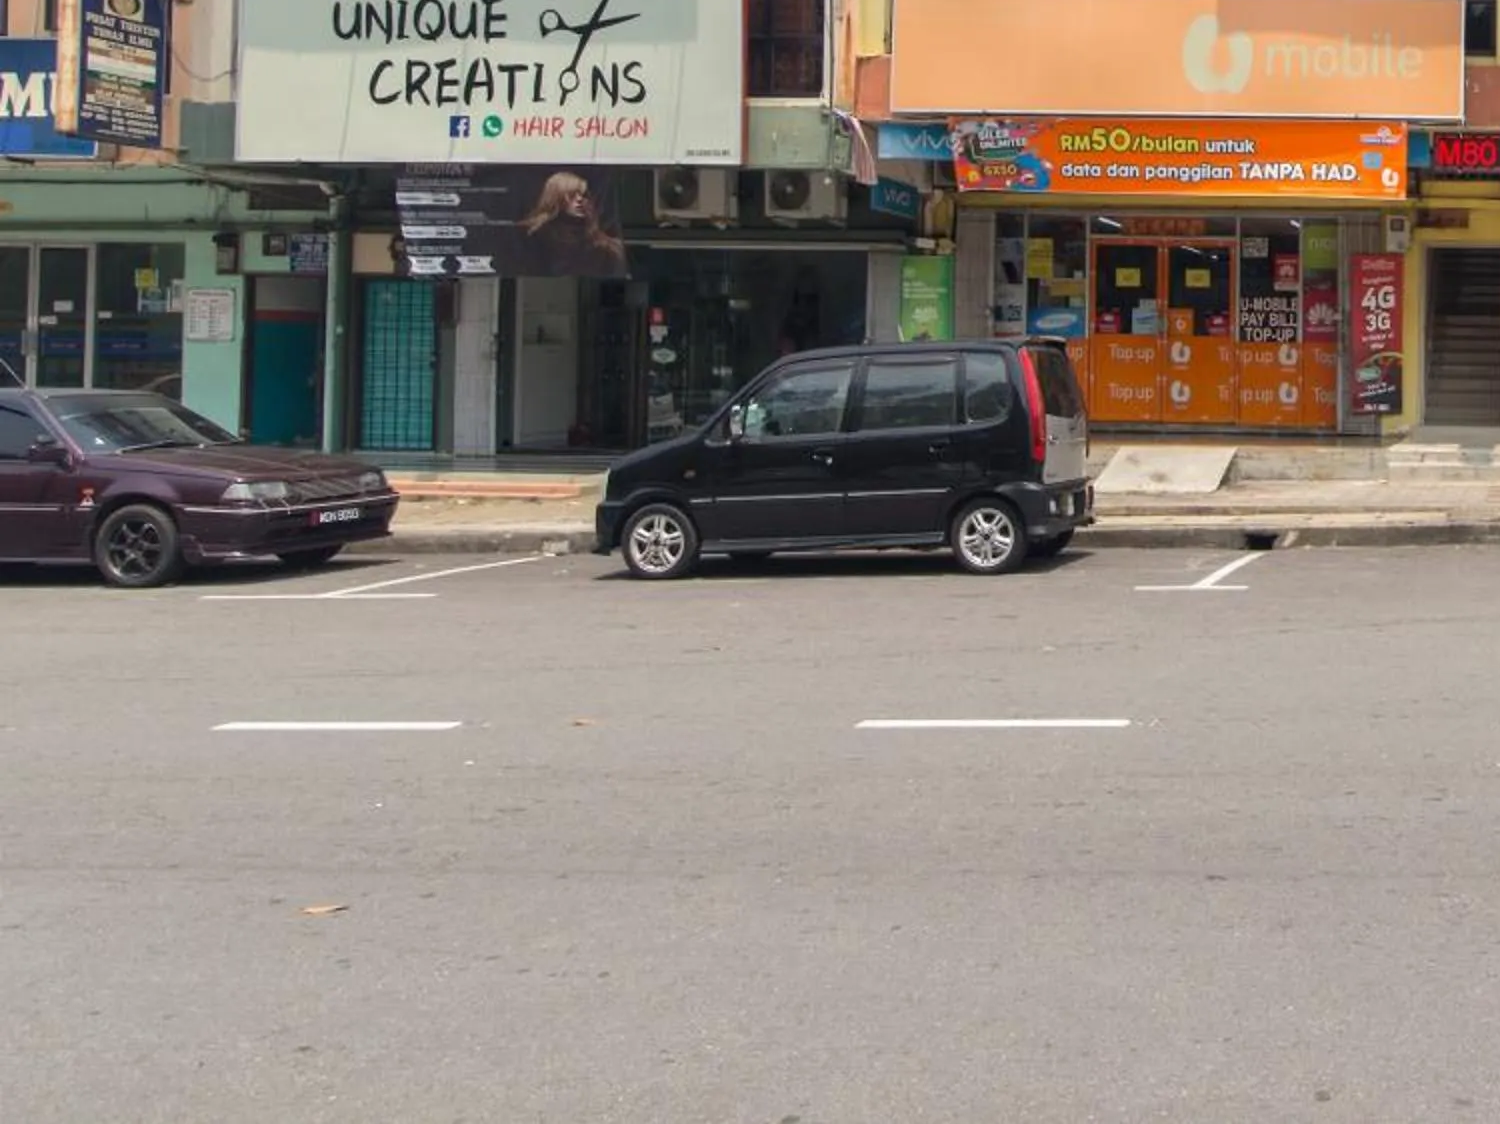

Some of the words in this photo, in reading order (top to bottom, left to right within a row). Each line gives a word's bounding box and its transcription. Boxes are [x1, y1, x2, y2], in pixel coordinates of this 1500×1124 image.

[1265, 31, 1425, 79] mobile
[513, 114, 564, 138] HAIR
[573, 115, 649, 139] SALON
[1060, 127, 1200, 153] RM50/bulan
[1204, 139, 1255, 154] untuk
[1060, 163, 1101, 178] data
[1106, 163, 1140, 178] dan
[1144, 163, 1234, 182] panggilan
[1238, 163, 1306, 181] TANPA
[1311, 163, 1362, 182] HAD.
[1361, 285, 1397, 310] 4G
[1241, 312, 1266, 327] PAY
[1268, 313, 1299, 328] BILL
[1365, 312, 1392, 332] 3G
[1245, 327, 1295, 342] TOP-UP
